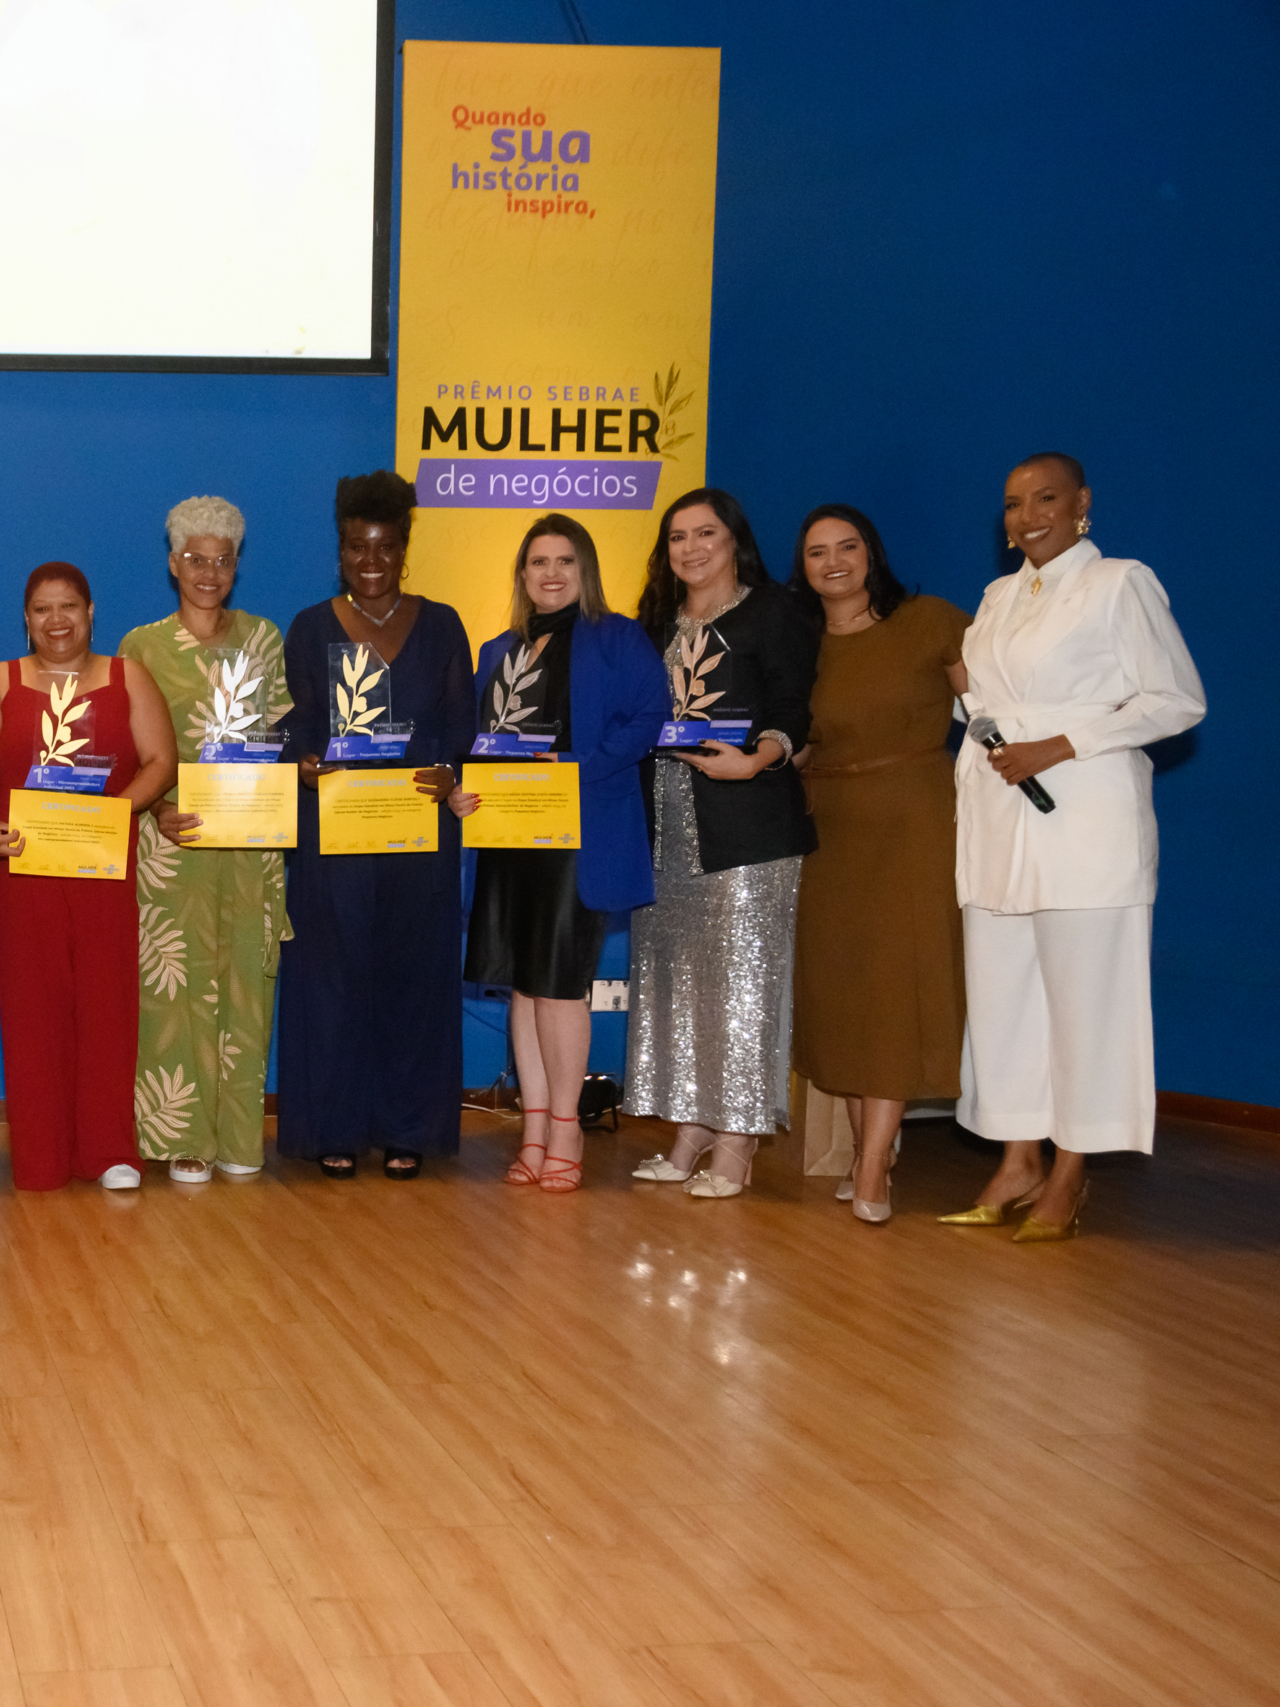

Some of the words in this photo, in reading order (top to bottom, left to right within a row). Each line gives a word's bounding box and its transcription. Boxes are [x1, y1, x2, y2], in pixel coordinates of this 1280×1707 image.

[452, 104, 546, 130] Quando
[490, 127, 591, 164] sua
[452, 161, 579, 192] história
[507, 191, 596, 219] inspira,
[437, 380, 533, 400] PRÊMIO
[547, 385, 640, 402] SEBRAE
[421, 406, 661, 453] MULHER
[436, 463, 476, 495] de
[489, 467, 638, 505] negócios
[348, 779, 407, 788] CERTIFICADO
[494, 773, 551, 781] CERTIFICADO
[42, 802, 101, 814] CERTIFICADO
